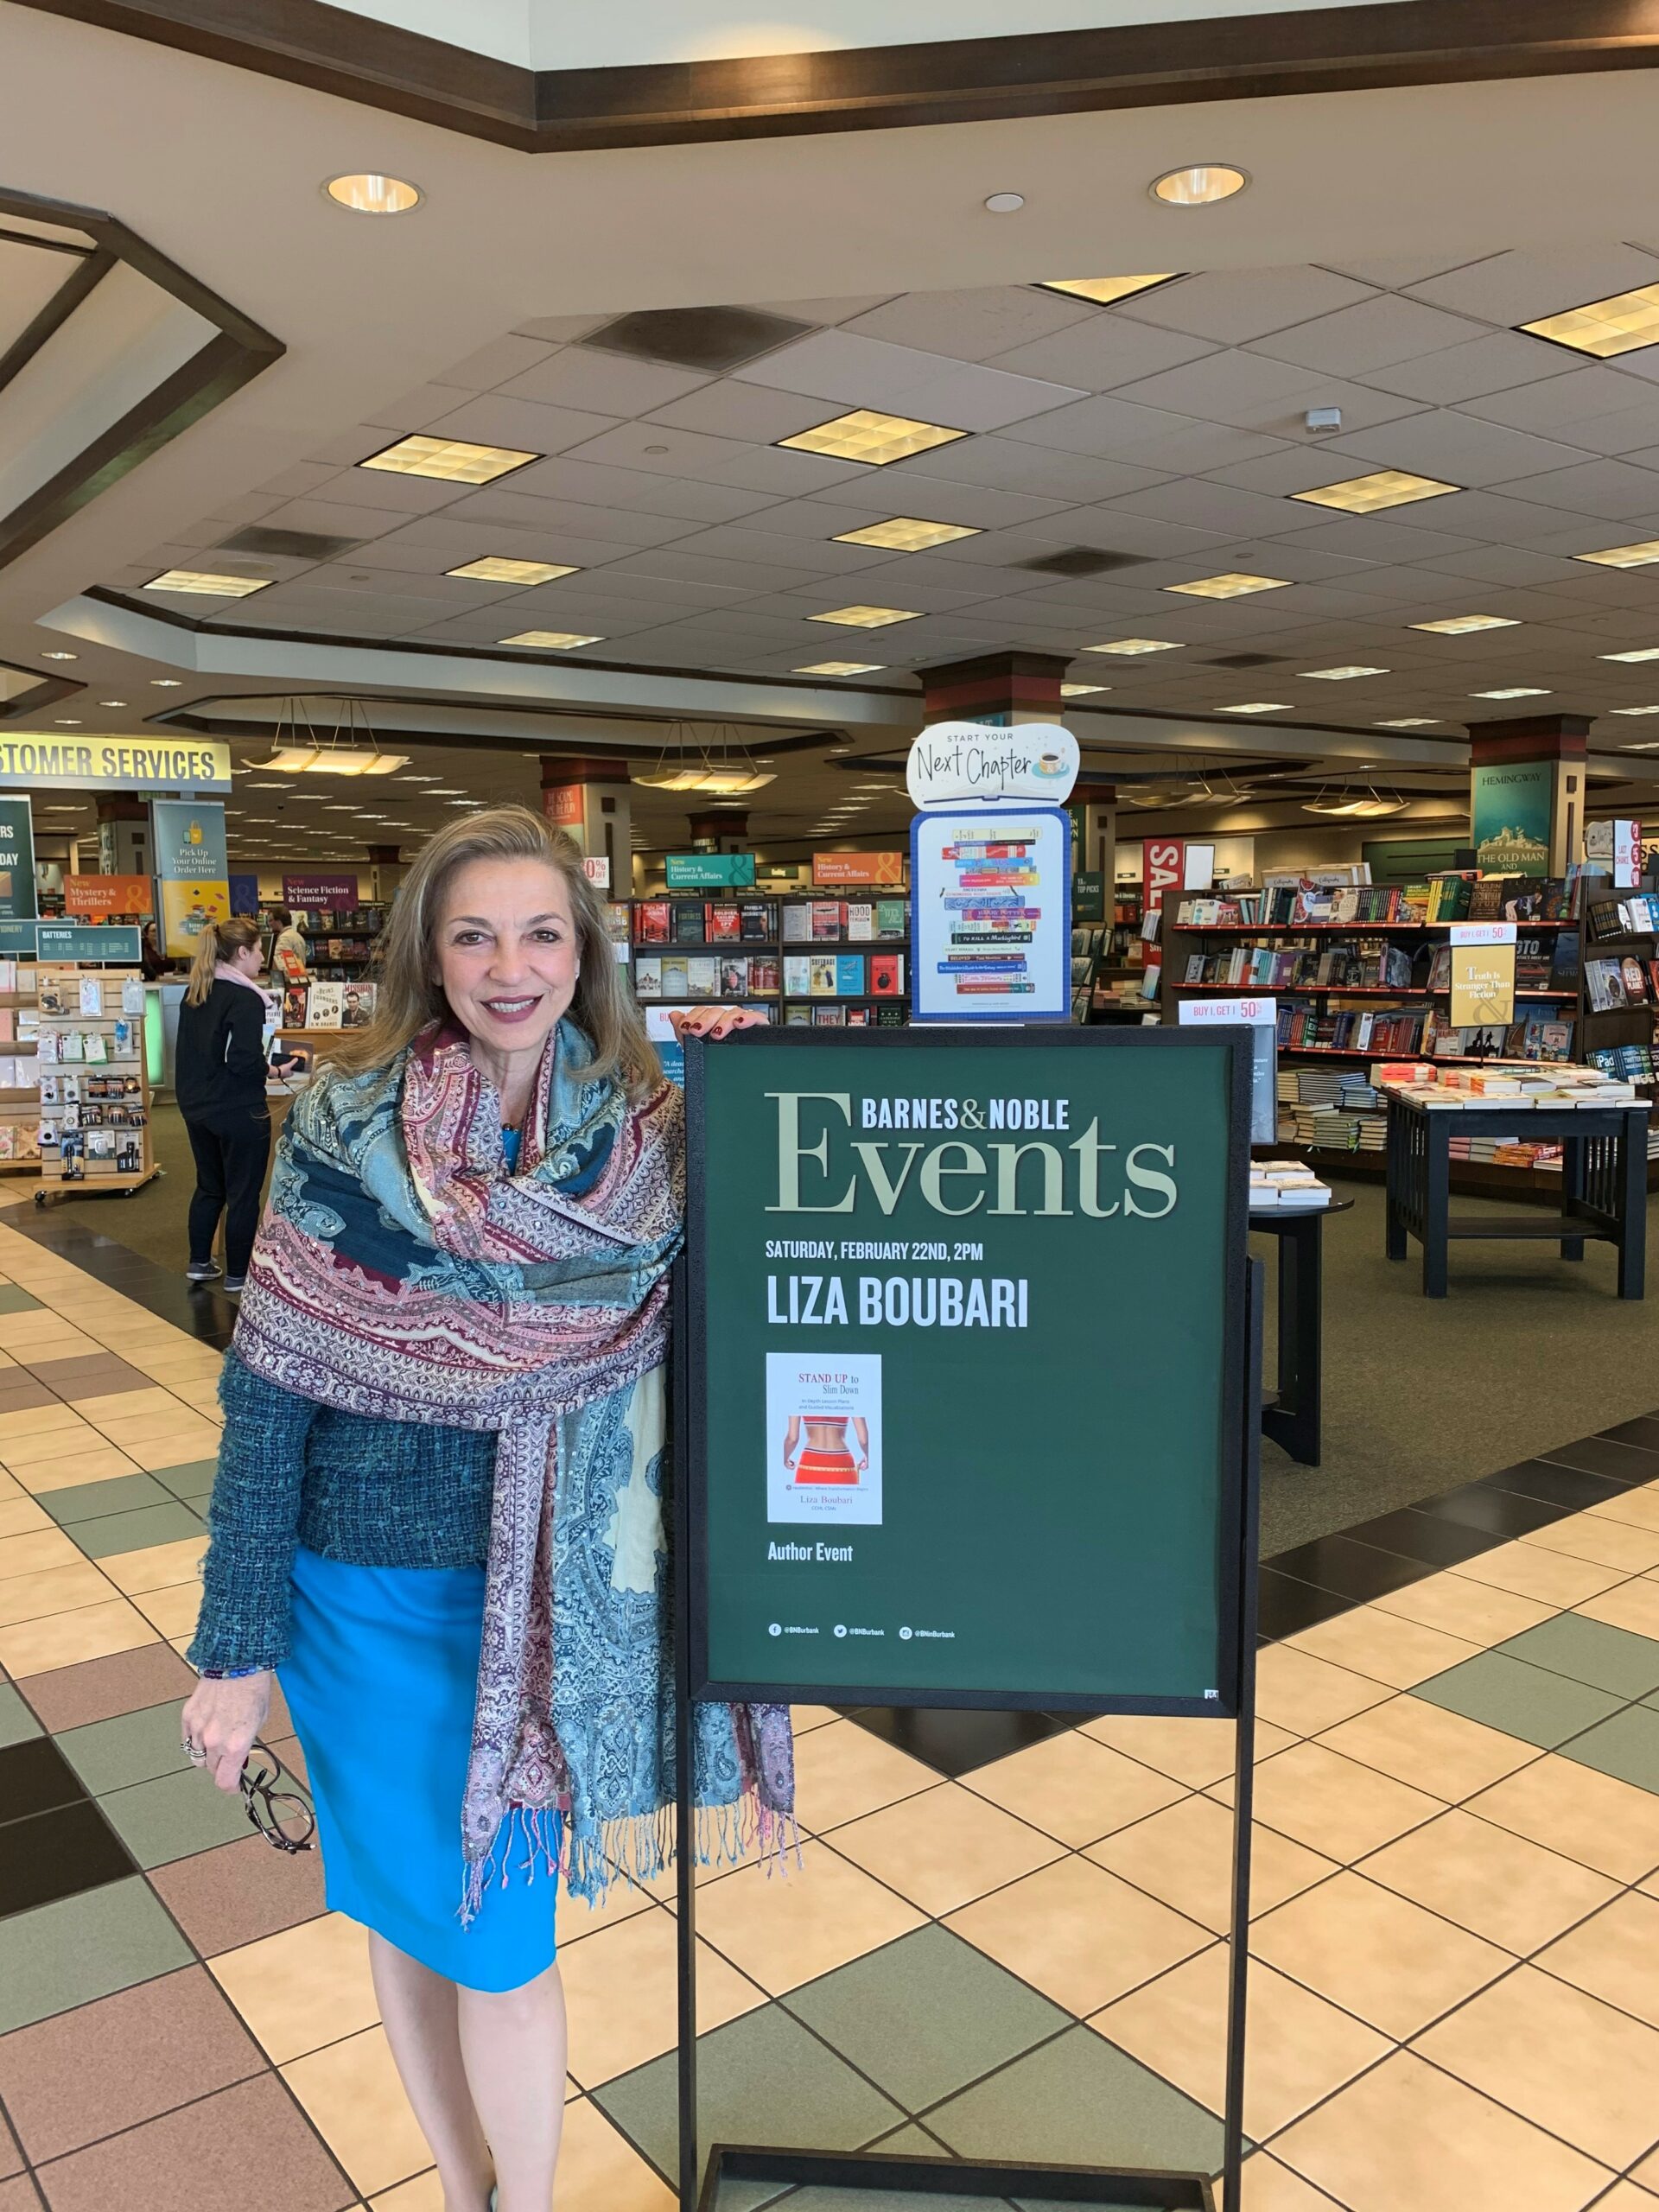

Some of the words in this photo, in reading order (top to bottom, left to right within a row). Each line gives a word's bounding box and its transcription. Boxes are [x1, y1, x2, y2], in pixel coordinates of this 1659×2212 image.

[947, 734, 979, 743] START
[0, 743, 92, 776] TOMER
[101, 747, 215, 779] SERVICES
[917, 744, 963, 781] Next
[966, 747, 1032, 791] Chapter
[1482, 772, 1542, 786] HEMINGWAY
[198, 849, 208, 858] Up
[1478, 854, 1496, 864] THE
[1498, 853, 1519, 863] OLD
[1521, 851, 1545, 861] MAN
[174, 866, 196, 874] Order
[198, 866, 217, 874] Here
[1149, 844, 1179, 910] SAL
[70, 887, 107, 898] Mystery
[287, 886, 320, 894] Science
[321, 886, 349, 894] Fiction
[71, 897, 111, 906] Thrillers
[296, 894, 328, 905] Fantasy
[849, 906, 870, 916] HOOD
[41, 930, 73, 939] BATTERIES
[1466, 966, 1492, 982] Truth
[1624, 967, 1641, 982] RED
[1455, 982, 1489, 991] Stranger
[1627, 981, 1643, 990] PLANET
[1469, 989, 1497, 999] Fiction
[1193, 1006, 1209, 1016] BUY
[1217, 1006, 1231, 1015] GET
[817, 1014, 841, 1025] THEY
[1595, 1054, 1615, 1069] iPad
[764, 1092, 1178, 1219] Events
[766, 1240, 837, 1261] SATURDAY,
[840, 1241, 909, 1260] FEBRUARY
[912, 1243, 950, 1262] 22ND,
[954, 1243, 983, 1261] 2PM
[767, 1275, 849, 1325] LIZA
[859, 1276, 1028, 1328] BOUBARI
[798, 1373, 832, 1383] STAND
[835, 1374, 848, 1383] UP
[851, 1376, 859, 1384] to
[823, 1384, 838, 1395] Slim
[840, 1384, 859, 1395] Down
[800, 1495, 817, 1503] Liza
[821, 1496, 853, 1504] Boubari
[767, 1541, 813, 1560] Author
[816, 1541, 854, 1561] Event
[784, 1626, 819, 1635] @BNBurbank
[849, 1628, 885, 1637] @BNBurbank
[914, 1630, 956, 1639] @BNinBurbank
